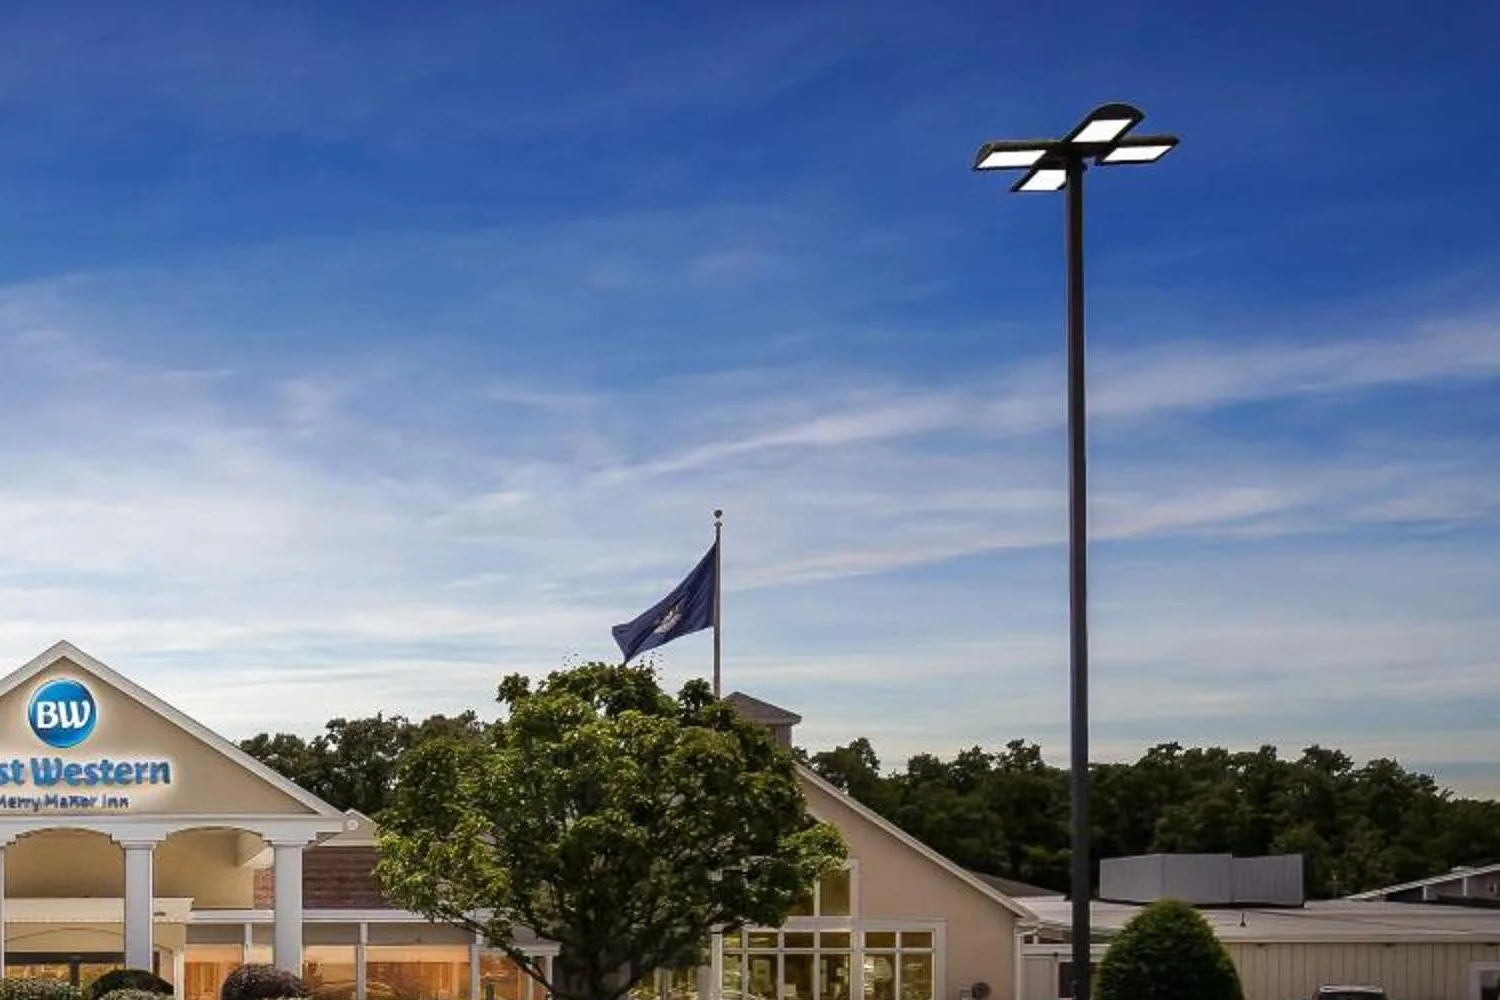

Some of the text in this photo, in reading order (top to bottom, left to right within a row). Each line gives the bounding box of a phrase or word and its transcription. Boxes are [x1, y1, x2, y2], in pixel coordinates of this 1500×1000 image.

[36, 700, 91, 729] BW
[29, 757, 172, 787] Western
[101, 792, 130, 809] Inn
